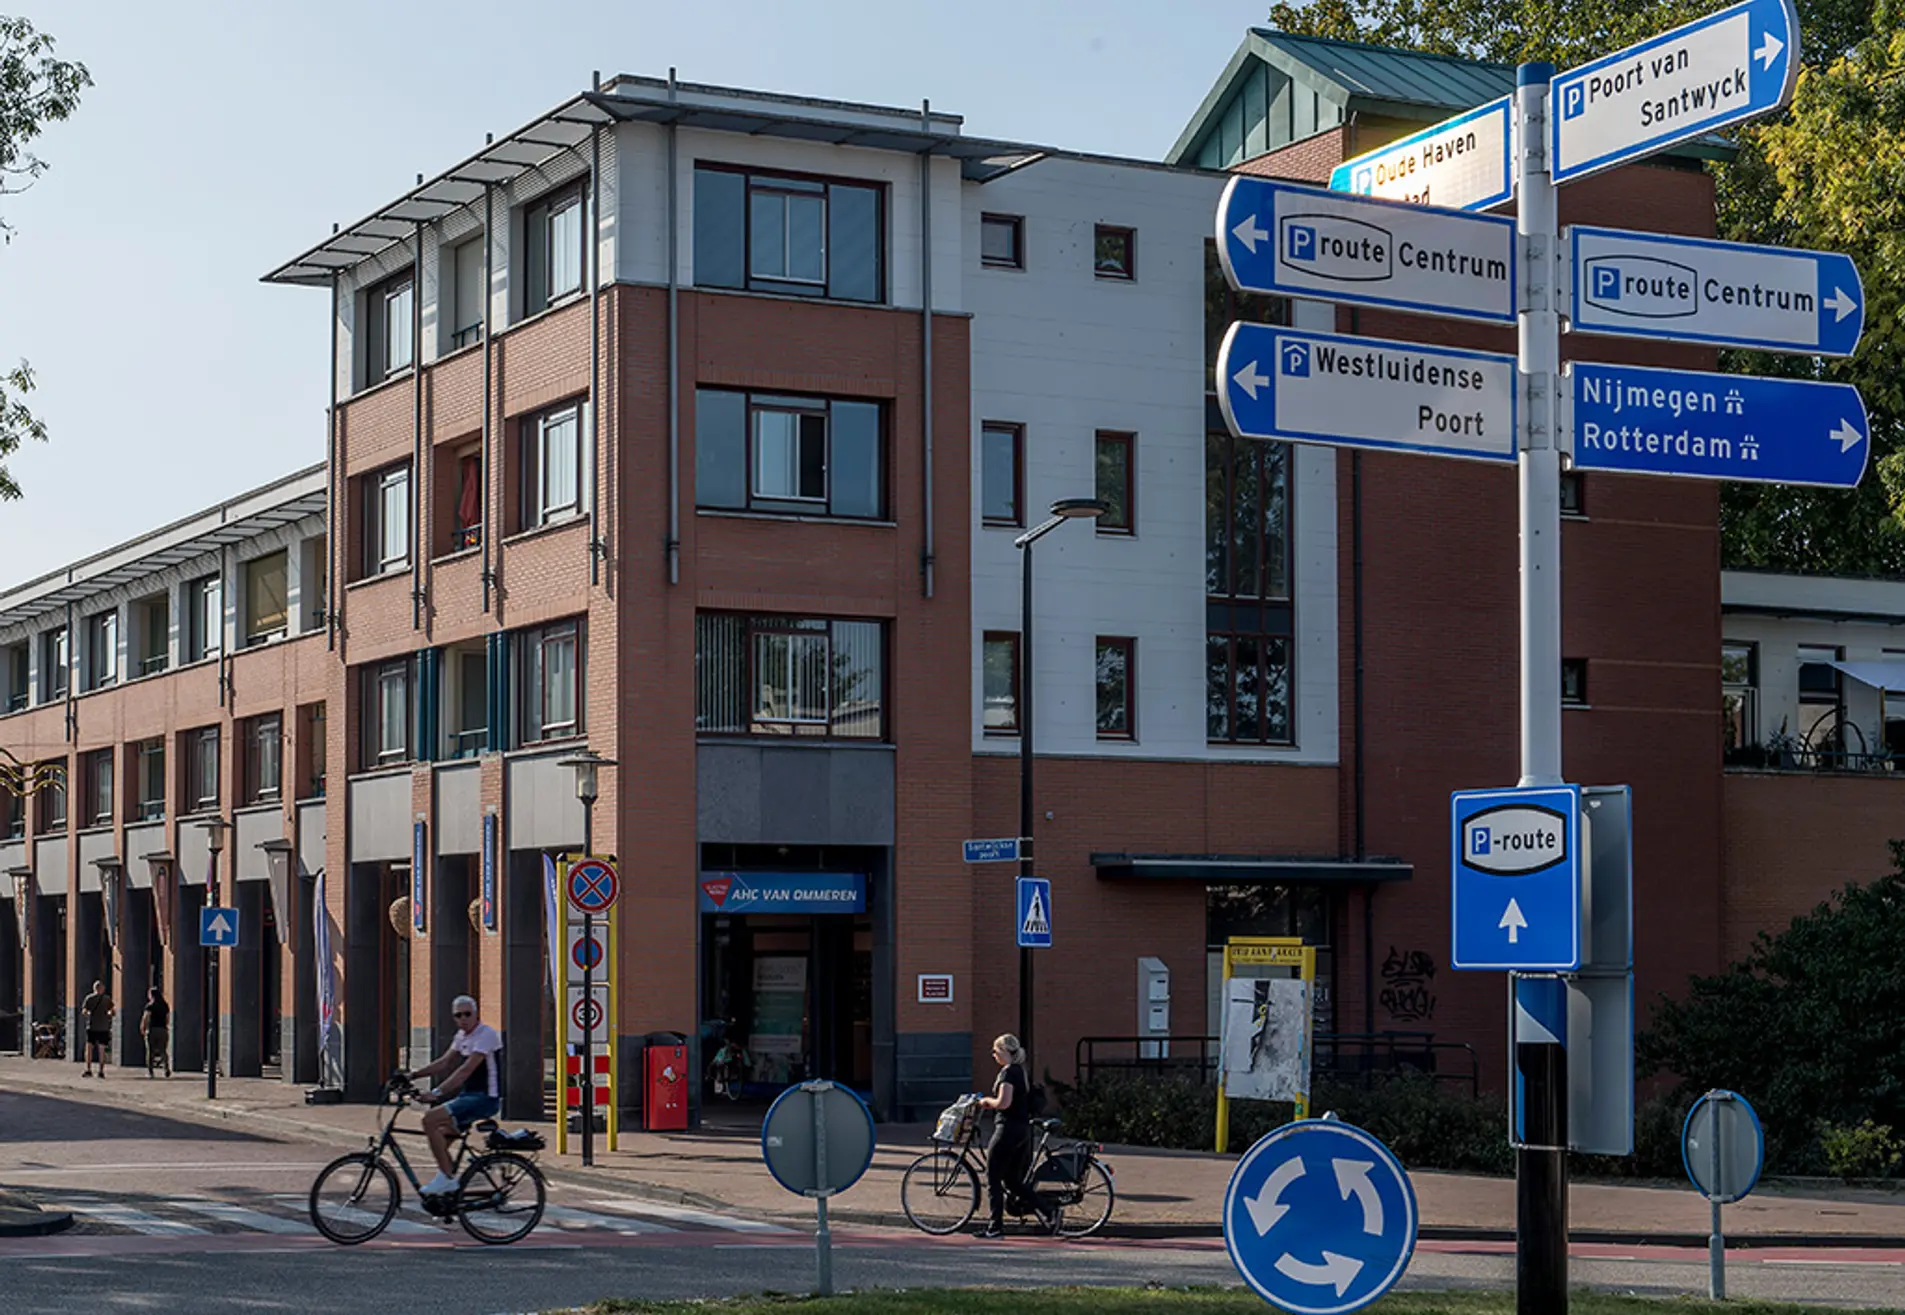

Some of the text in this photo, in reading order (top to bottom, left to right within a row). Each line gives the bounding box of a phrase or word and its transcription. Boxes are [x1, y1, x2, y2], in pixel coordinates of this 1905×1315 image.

[1589, 61, 1644, 104] Poort
[1651, 47, 1690, 80] van
[1640, 66, 1748, 127] Santwyck
[1375, 154, 1416, 186] Oude
[1422, 131, 1477, 169] Haven
[1319, 233, 1386, 263] route
[1398, 241, 1508, 281] Centrum
[1624, 273, 1690, 299] route
[1703, 278, 1815, 313] Centrum
[1316, 345, 1484, 390] Westluidense
[1582, 376, 1718, 418] Nijmegen
[1418, 404, 1485, 436] Poort
[1582, 422, 1732, 459] Rotterdam
[731, 888, 760, 901] AHC
[762, 889, 790, 901] VAN
[793, 889, 858, 901] OMMEREN
